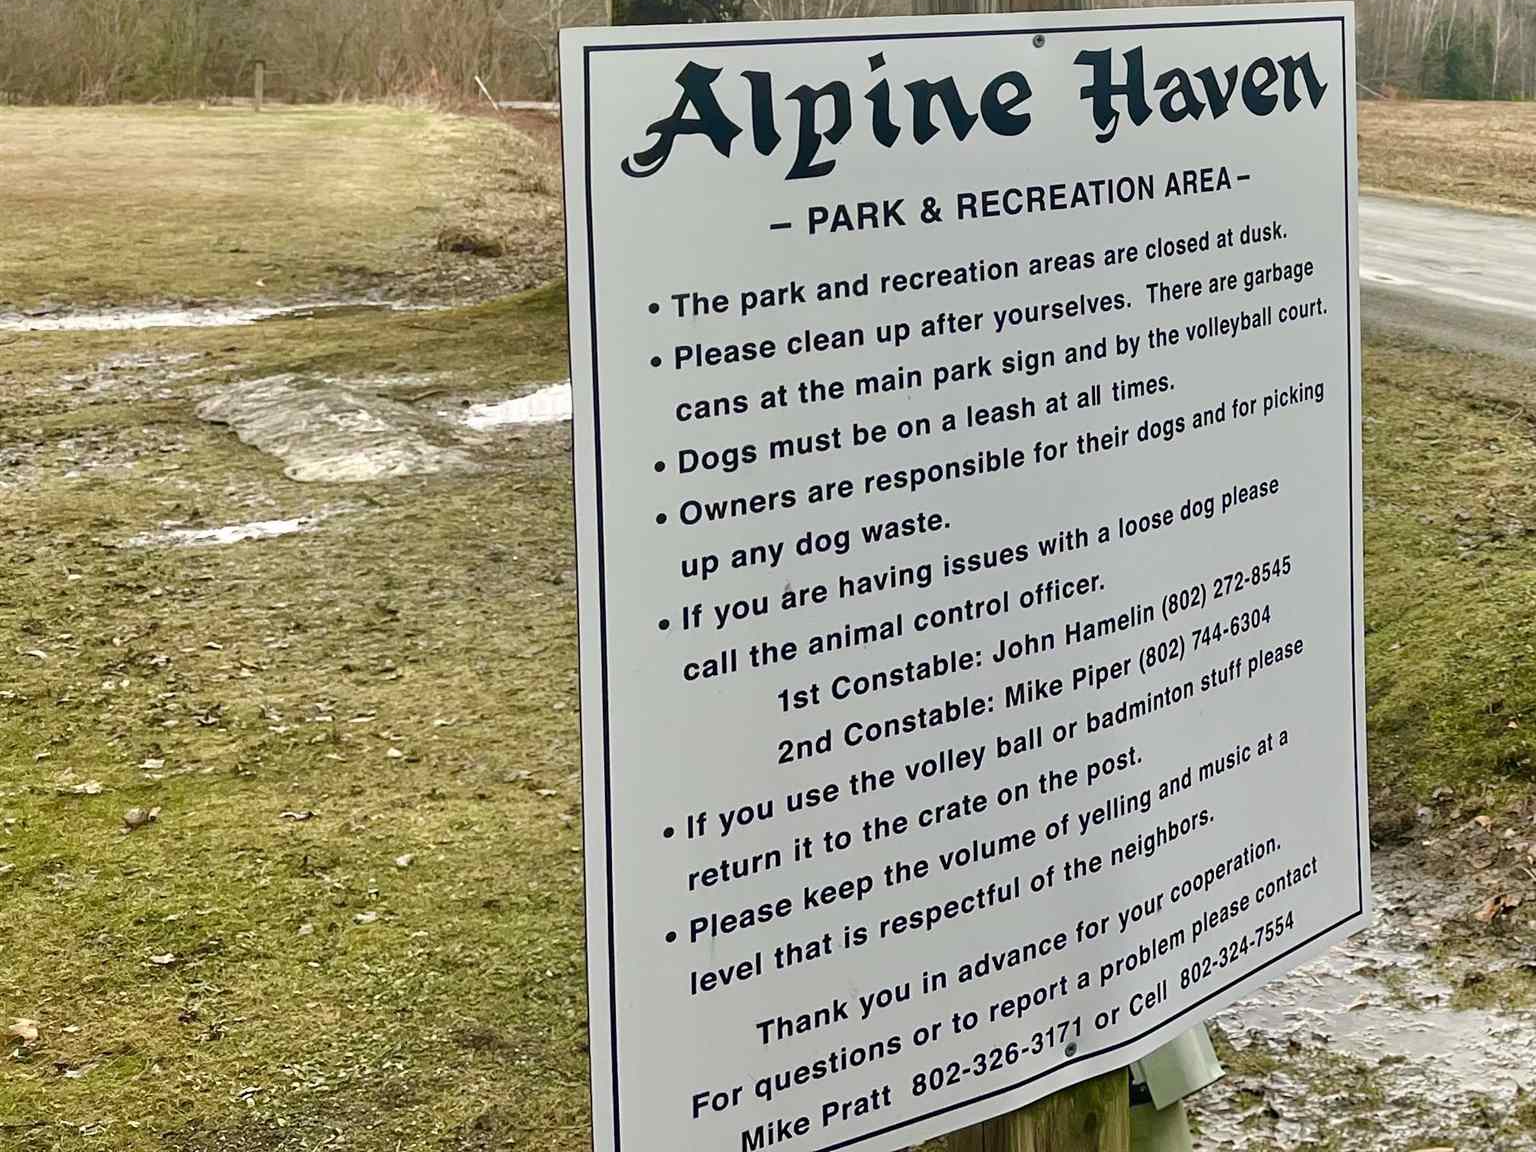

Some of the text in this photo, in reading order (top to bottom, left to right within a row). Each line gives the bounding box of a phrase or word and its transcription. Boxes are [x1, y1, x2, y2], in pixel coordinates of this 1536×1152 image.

[621, 46, 1330, 182] Alpine Haven
[670, 220, 1288, 318] The park and recreation areas are closed at dusk.
[808, 198, 907, 236] PARK
[920, 196, 944, 225] &
[956, 174, 1155, 221] RECREATION
[674, 260, 1314, 370] Please clean up after yourselves. There are garbage
[675, 297, 1328, 422] cans at the main park sign and by the volleyball court.
[678, 375, 1175, 475] Dogs must be on a leash at all times.
[679, 382, 1324, 526] Owners are responsible for their dogs and for picking
[681, 512, 951, 581] up any dog waste.
[682, 478, 1280, 631] If you are having issues with a loose dog please
[683, 574, 1105, 682] call the animal control officer.
[777, 554, 1291, 713] 1st Constable: John Hamelin (802) 272-8545
[777, 604, 1271, 765] 2nd Constable: Mike Piper (802) 744-6304
[687, 639, 1304, 840] If you use the volley ball or badminton stuff please
[688, 745, 1142, 892] return it to the crate on the post.
[690, 729, 1289, 944] Please keep the volume of yelling and music at a
[690, 809, 1215, 996] level that is respectful of the neighbors.
[755, 837, 1281, 1045] Thank you in advance for your cooperation.
[692, 855, 1318, 1120] For questions or to report a problem please contact
[741, 910, 1295, 1152] Mike Pratt 802-326-3171 or Cell 802-324-7554
